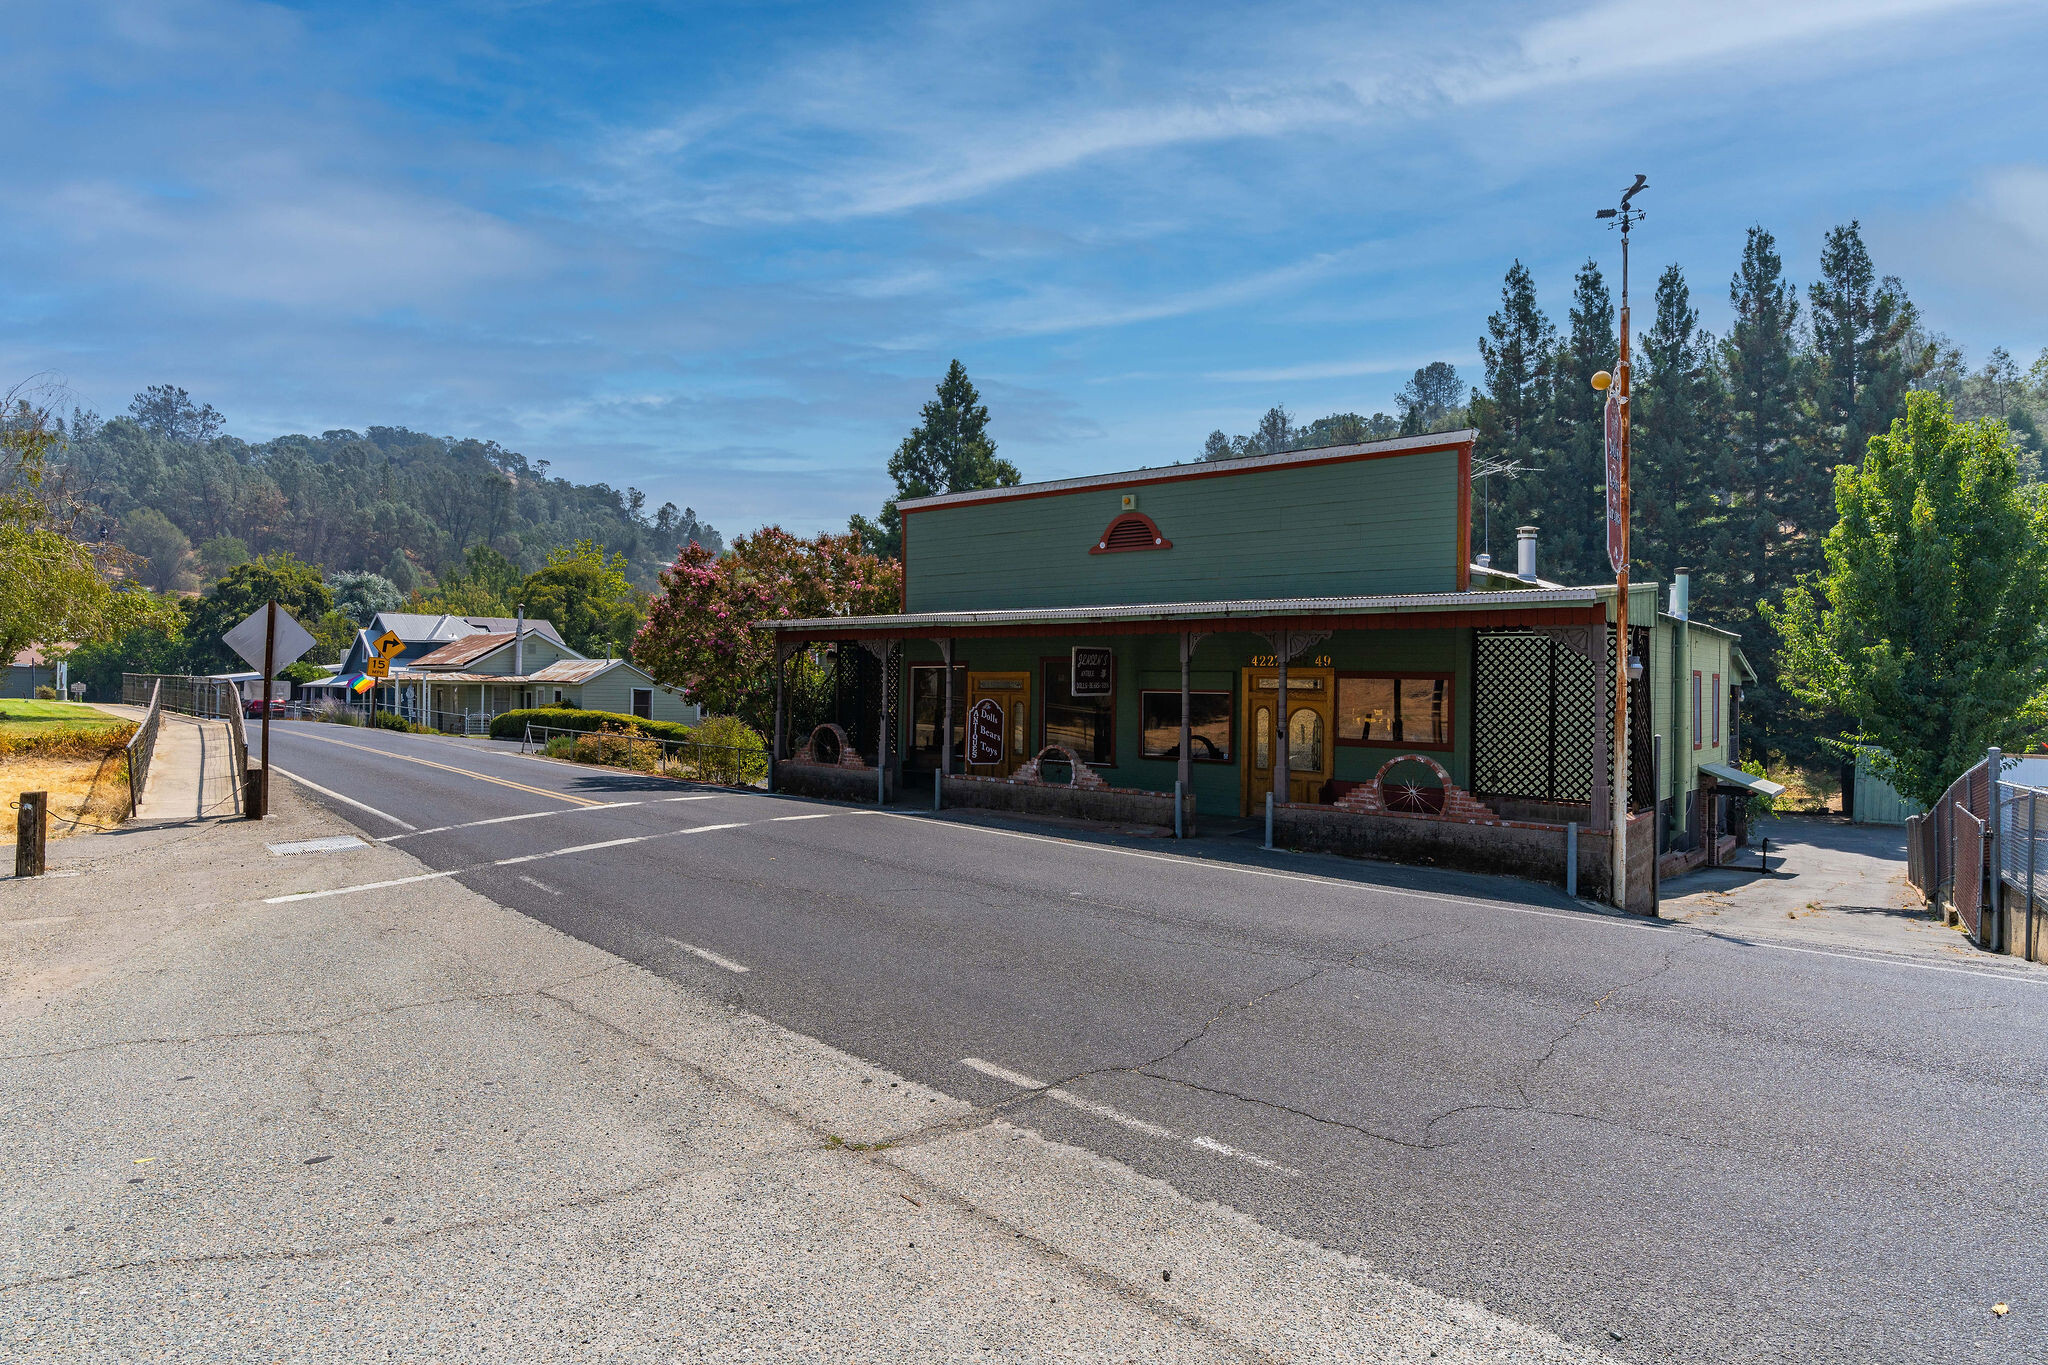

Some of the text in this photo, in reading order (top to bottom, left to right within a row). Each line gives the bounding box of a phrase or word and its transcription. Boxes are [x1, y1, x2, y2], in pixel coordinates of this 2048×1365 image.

[373, 660, 385, 668] 15
[1314, 655, 1331, 667] 49
[981, 709, 998, 724] Dolls
[980, 725, 1001, 741] Bears
[980, 741, 998, 757] Toys
